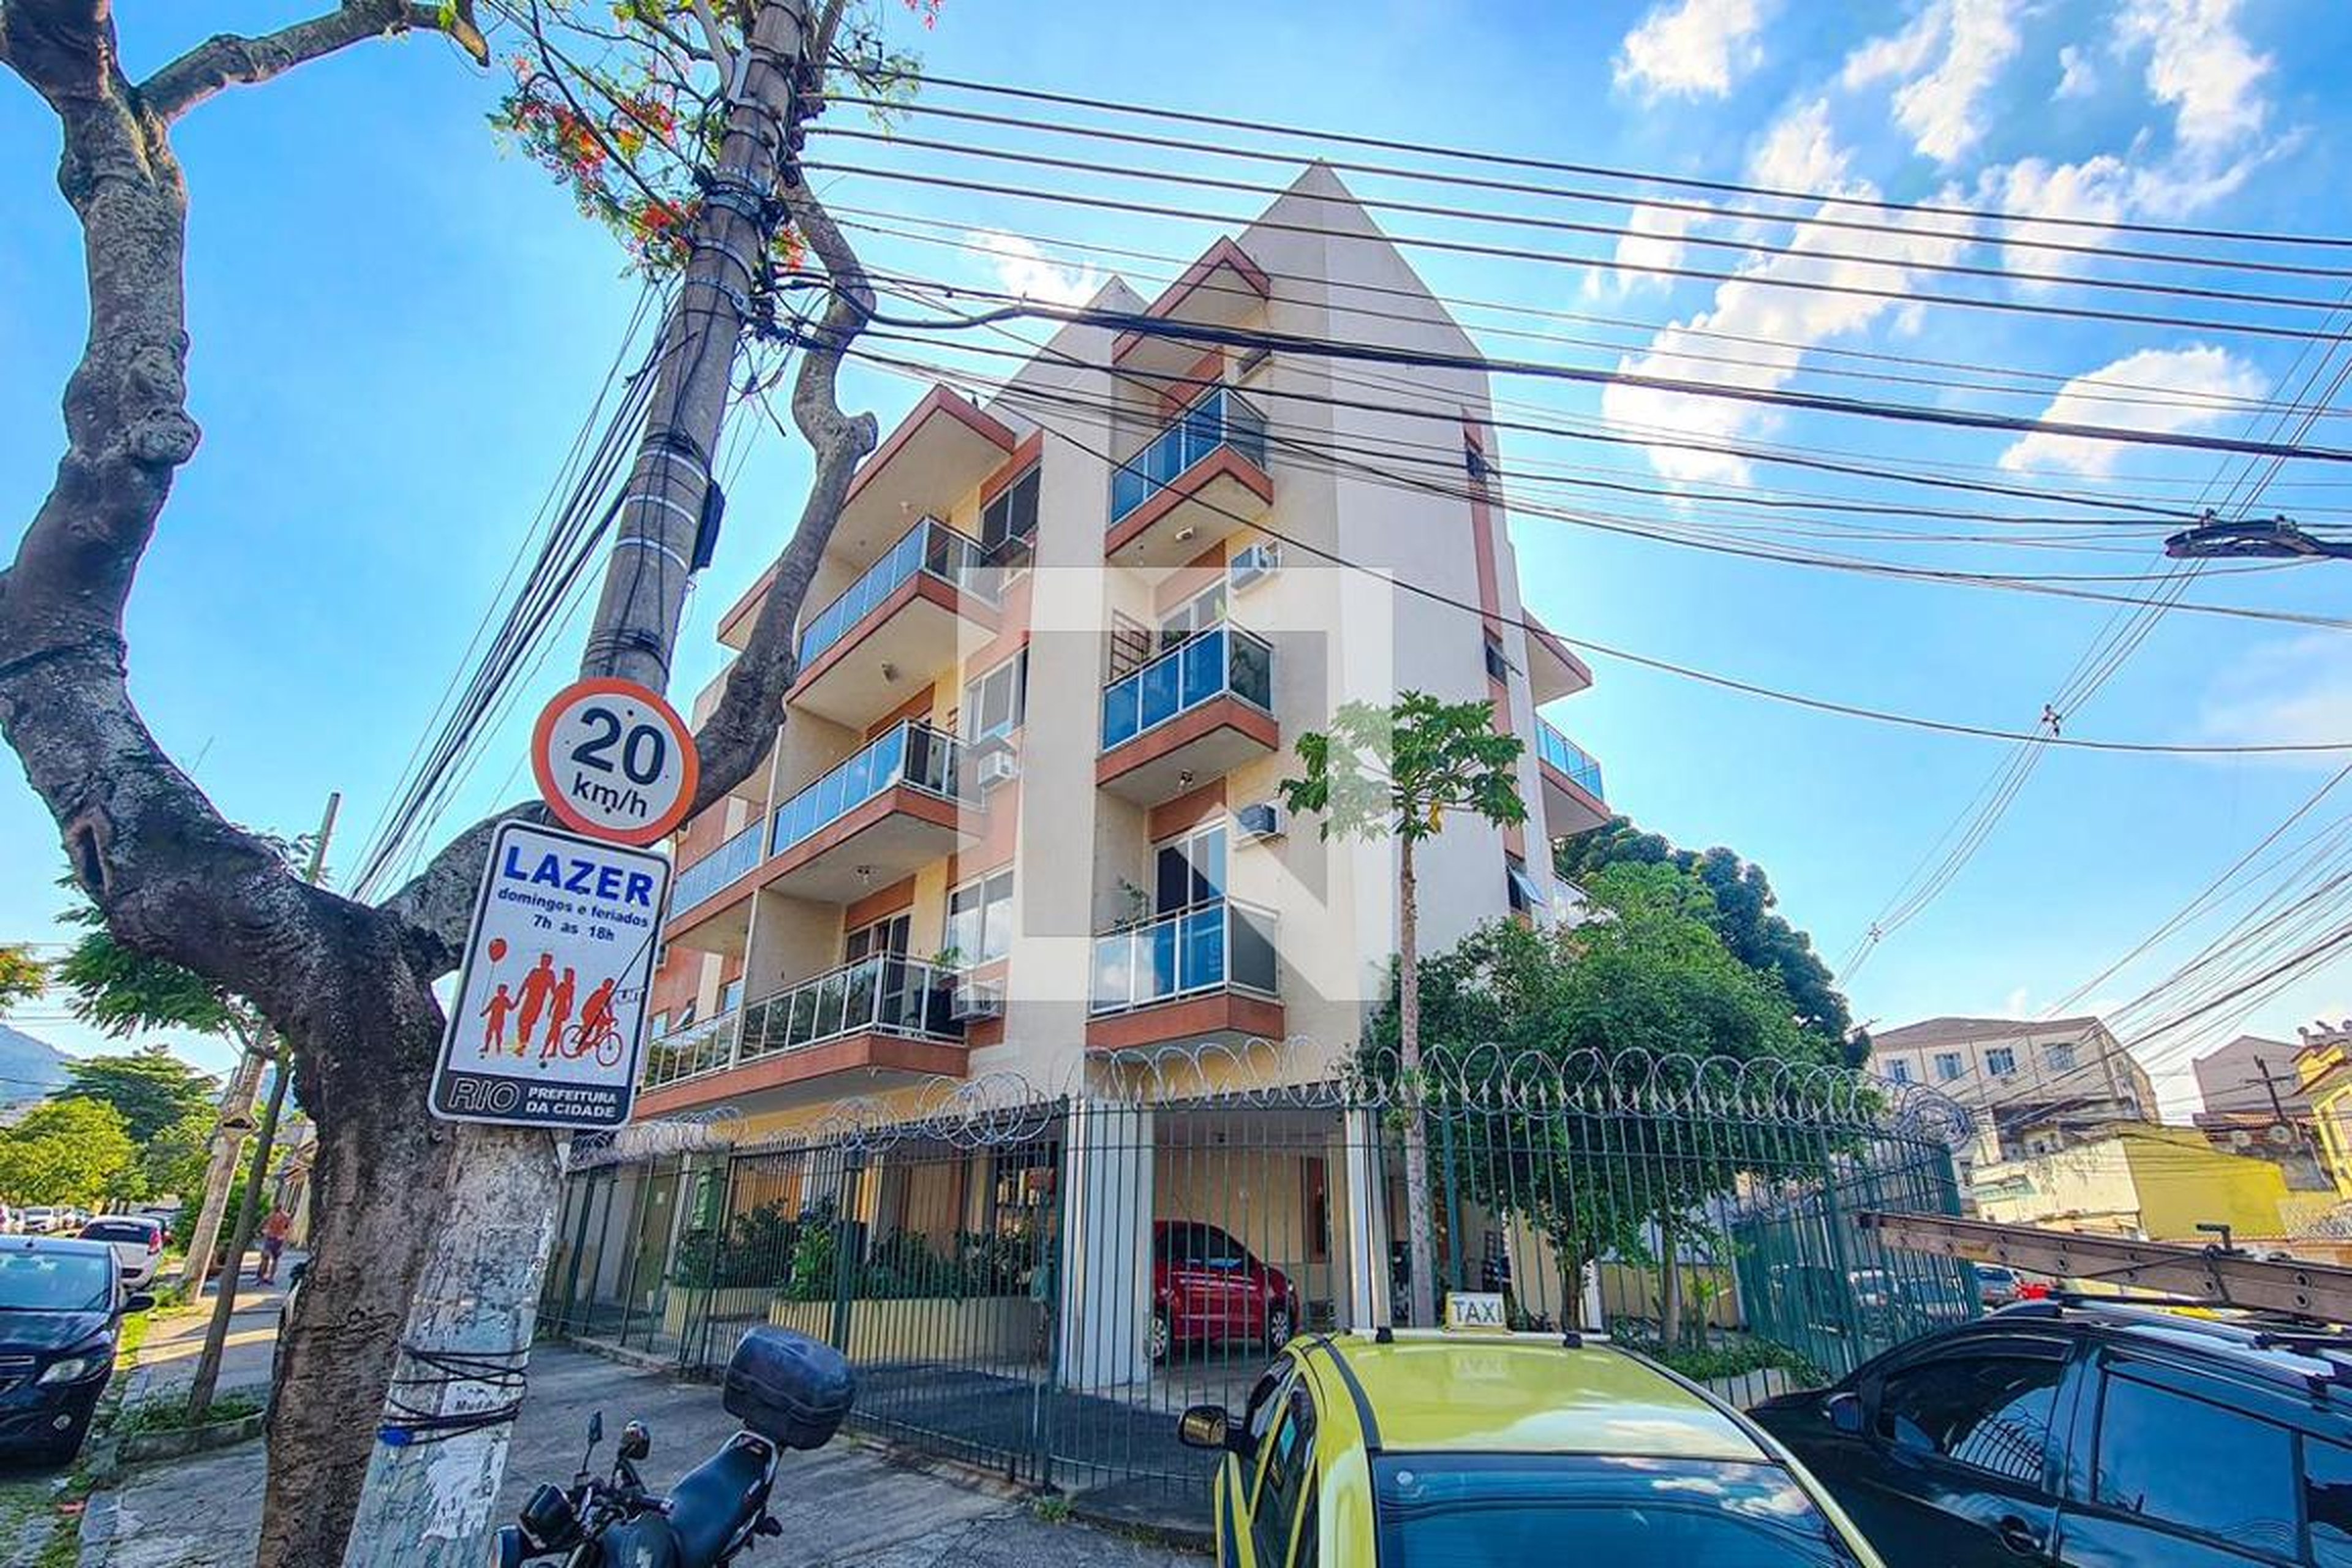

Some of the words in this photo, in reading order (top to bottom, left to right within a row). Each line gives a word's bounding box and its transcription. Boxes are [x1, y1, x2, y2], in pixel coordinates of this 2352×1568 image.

[571, 707, 666, 785] 20
[572, 772, 647, 818] km/h
[503, 846, 654, 907] LAZER
[498, 887, 573, 912] domingos
[577, 905, 587, 915] e
[591, 905, 649, 927] feriados
[533, 914, 552, 929] 7h
[589, 925, 615, 941] 18h
[448, 1077, 520, 1114] RIO
[526, 1101, 549, 1114] DA
[552, 1103, 616, 1118] CIDADE
[528, 1086, 616, 1103] PREFEITURA
[1452, 1300, 1503, 1323] TAXI
